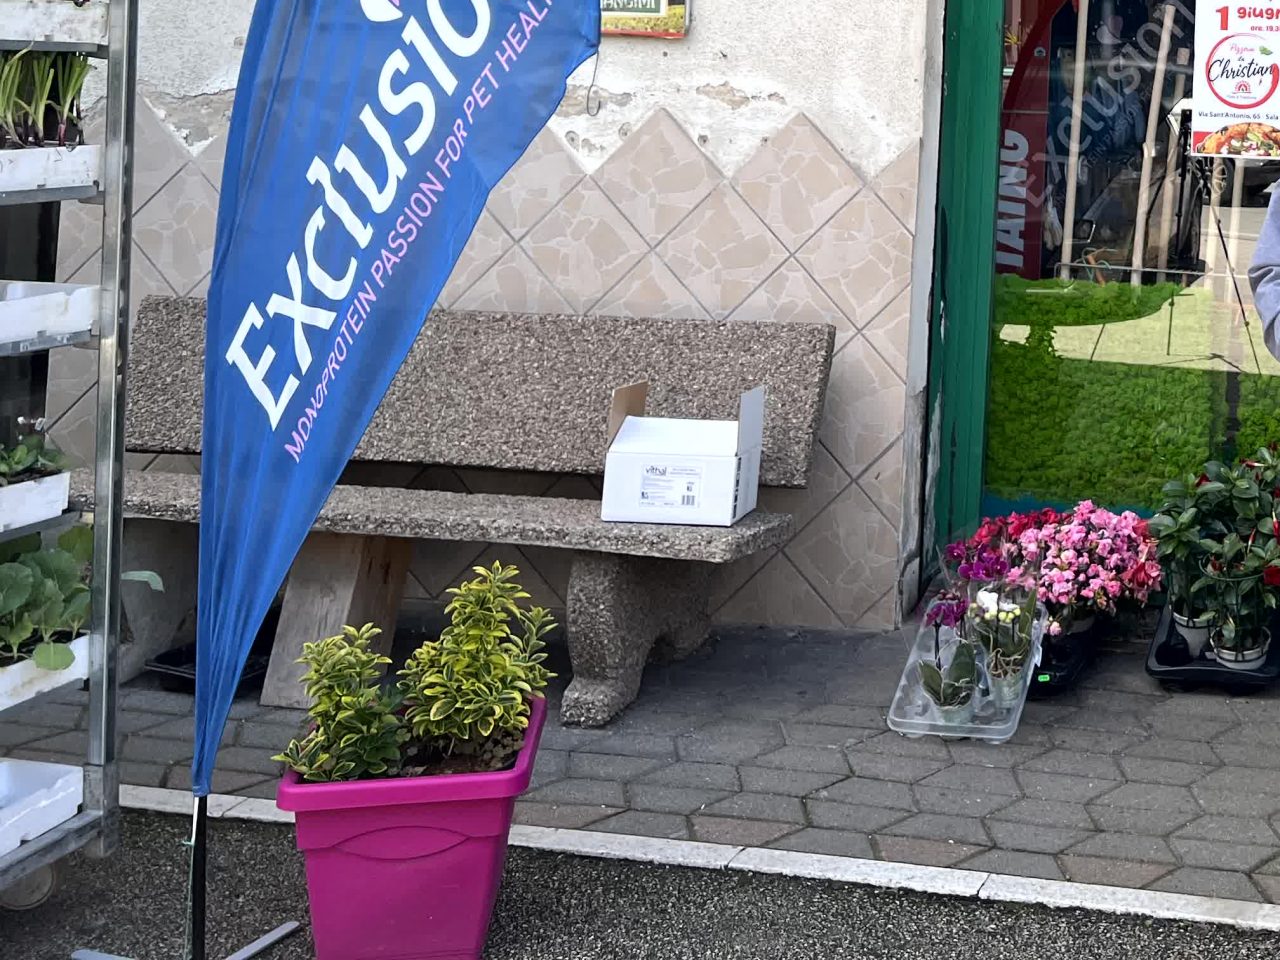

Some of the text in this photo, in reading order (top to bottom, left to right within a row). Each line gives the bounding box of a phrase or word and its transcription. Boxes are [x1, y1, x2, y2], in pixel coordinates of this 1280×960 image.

[1215, 6, 1229, 30] 1
[1207, 57, 1274, 82] Christian
[283, 280, 378, 464] MONOPROTEIN
[371, 171, 440, 291] PASSION
[437, 123, 469, 183] FOR
[463, 75, 500, 125] PET
